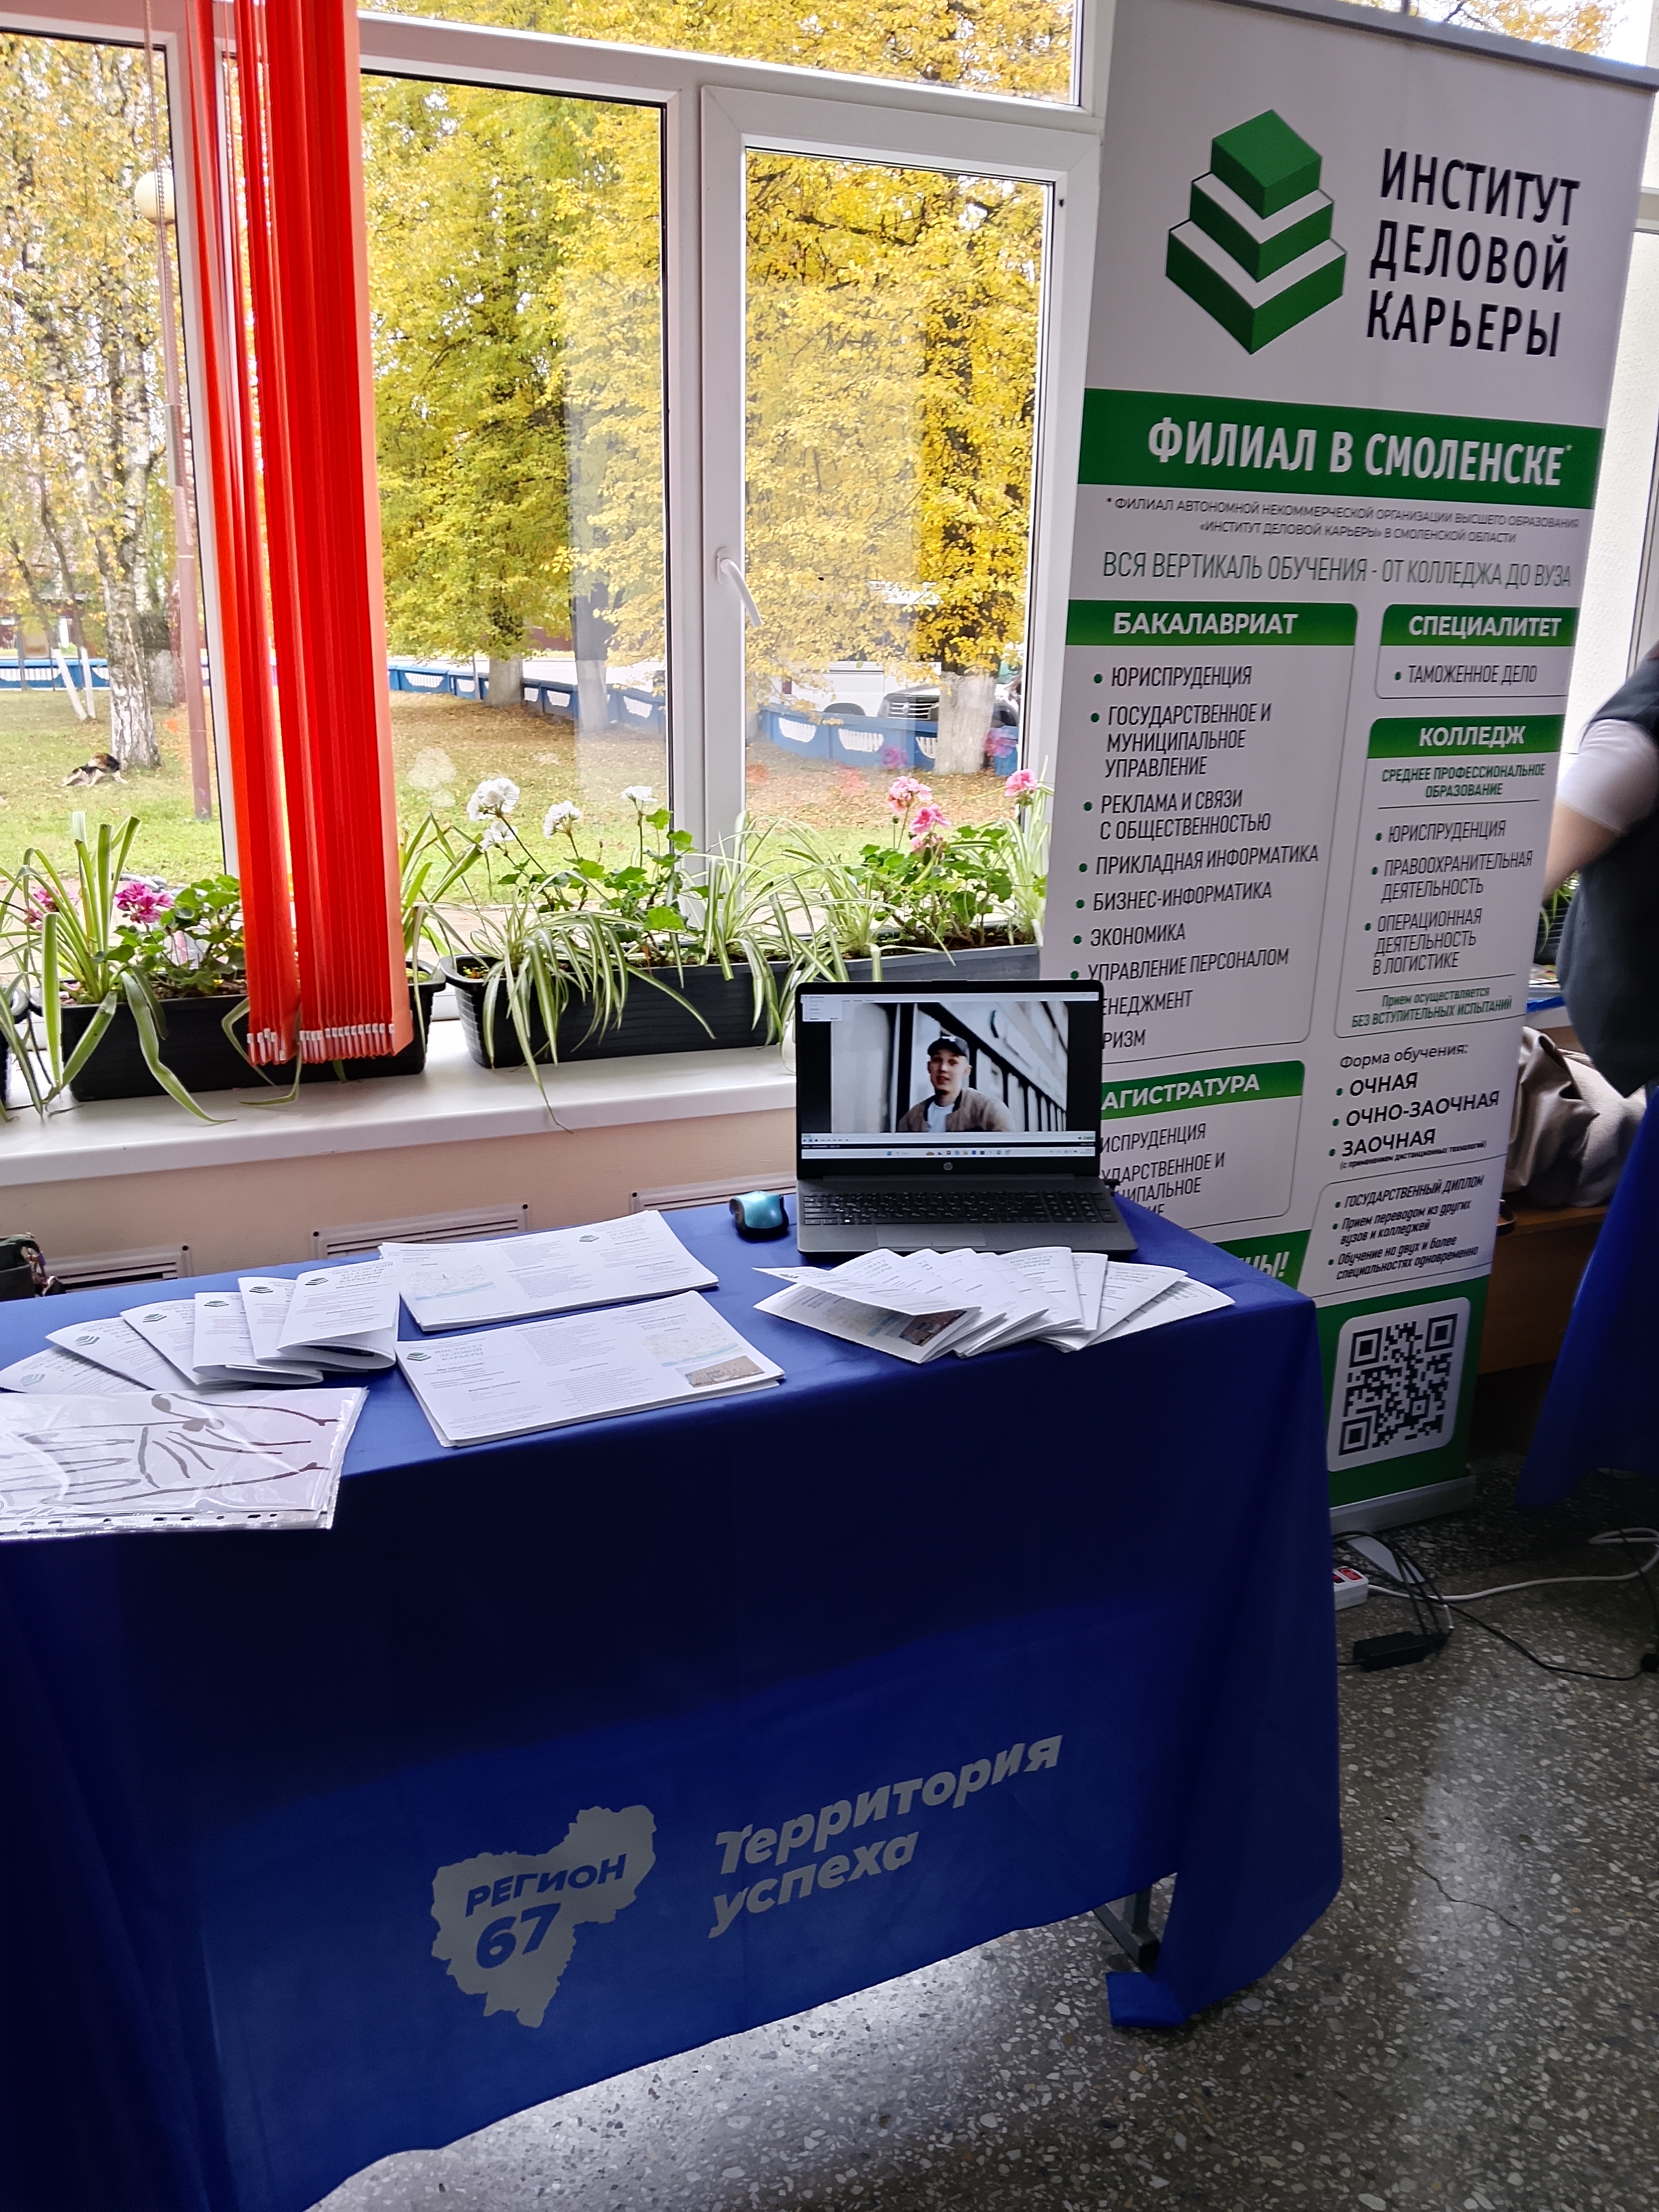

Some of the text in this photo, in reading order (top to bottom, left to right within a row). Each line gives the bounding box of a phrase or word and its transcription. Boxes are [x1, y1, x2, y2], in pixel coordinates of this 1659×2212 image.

[1380, 148, 1581, 226] ИНСТИТУТ
[1370, 220, 1569, 293] ДЕЛОВОЙ
[1367, 290, 1561, 356] КАРЬЕРЫ
[1148, 417, 1316, 471] ФИЛИАЛ
[1330, 431, 1351, 473] В
[1115, 497, 1579, 529] ФИЛИАЛ АВТОНОМНОЙ НЕКОММЕРЧЕСКОЙ ОРГАНИЗАЦИИ ВЫСШЕГО ОБРАЗОВАНИЯ
[1199, 521, 1516, 543] «ИНСТИТУТ ДЕЛОВОЙ КАРЬЕРЫ» В СМОЛЕНСКОЙ ОБЛАСТИ
[1103, 551, 1146, 578] ВСЯ
[1154, 552, 1262, 579] ВЕРТИКАЛЬ
[1269, 555, 1367, 581] ОБУЧЕНИЯ
[1382, 559, 1405, 582] ОТ
[1407, 560, 1502, 589] КОЛЛЕДЖА
[1505, 563, 1530, 589] ДО
[1534, 564, 1571, 587] ВУЗА
[1113, 612, 1299, 635] БАКАЛАВРИАТ
[1408, 615, 1562, 639] СПЕЦИАЛИТЕТ
[1111, 665, 1252, 690] ЮРИСПРУДЕНЦИЯ
[1408, 665, 1537, 686] ТАМОЖЕННОЕ ДЕЛО
[1108, 703, 1272, 729] ГОСУДАРСТВЕННОЕ И
[1107, 729, 1246, 755] МУНИЦИПАЛЬНОЕ
[1419, 726, 1526, 748] КОЛЛЕДЖ
[1104, 756, 1208, 778] УПРАВЛЕНИЕ
[1381, 763, 1546, 783] СРЕДНЕЕ ПРОФЕССИОНАЛЬНОЕ
[1101, 789, 1243, 814] РЕКЛАМА И СВЯЗИ
[1425, 783, 1503, 798] ОБРАЗОВАНИЕ
[1100, 813, 1272, 841] С ОБЩЕСТВЕННОСТЬЮ
[1388, 820, 1506, 843] ЮРИСПРУДЕНЦИЯ
[1095, 844, 1319, 876] ПРИКЛАДНАЯ ИНФОРМАТИКА
[1384, 850, 1533, 877] ПРАВООХРАНИТЕЛЬНАЯ
[1093, 881, 1272, 912] БИЗНЕС-ИНФОРМАТИКА
[1380, 878, 1483, 903] ДЕЯТЕЛЬНОСТЬ
[1377, 908, 1482, 932] ОПЕРАЦИОННАЯ
[1090, 923, 1186, 947] ЭКОНОМИКА
[1374, 930, 1476, 957] ДЕЯТЕЛЬНОСТЬ
[1088, 948, 1289, 981] УПРАВЛЕНИЕ ПЕРСОНАЛОМ
[1373, 952, 1460, 975] В ЛОГИСТИКЕ
[1102, 989, 1193, 1016] ЕНЕДЖМЕНТ
[1352, 995, 1513, 1028] БЕЗ ВСТУПИТЕЛЬНЫХ ИСПЫТАНИЙ
[1382, 987, 1490, 1009] Прием осуществляется
[1103, 1029, 1146, 1048] РИЗМ
[1340, 1043, 1468, 1071] Форма обучения:
[1101, 1074, 1260, 1111] АГИСТРАТУРА
[1350, 1072, 1418, 1096] ОЧНАЯ
[1346, 1090, 1501, 1127] ОЧНО-ЗАОЧНАЯ
[1101, 1122, 1206, 1153] ИСПРУДЕНЦИЯ
[1341, 1128, 1436, 1157] ЗАОЧНАЯ
[1101, 1151, 1225, 1182] УДАРСТВЕННОЕ И
[1344, 1175, 1485, 1208] ГОСУДАРСТВЕННЫЙ ДИПЛОМ
[1341, 1200, 1472, 1231] Прием переводом из других
[1340, 1218, 1431, 1246] вузов и колледжей
[1336, 1246, 1479, 1280] специальностях одновременно
[1338, 1236, 1457, 1266] Обучение на двух и более
[714, 1734, 1064, 1875] Территория
[464, 1852, 628, 1918] РЕГИОН
[707, 1830, 920, 1939] успеха
[476, 1903, 562, 1970] 67
